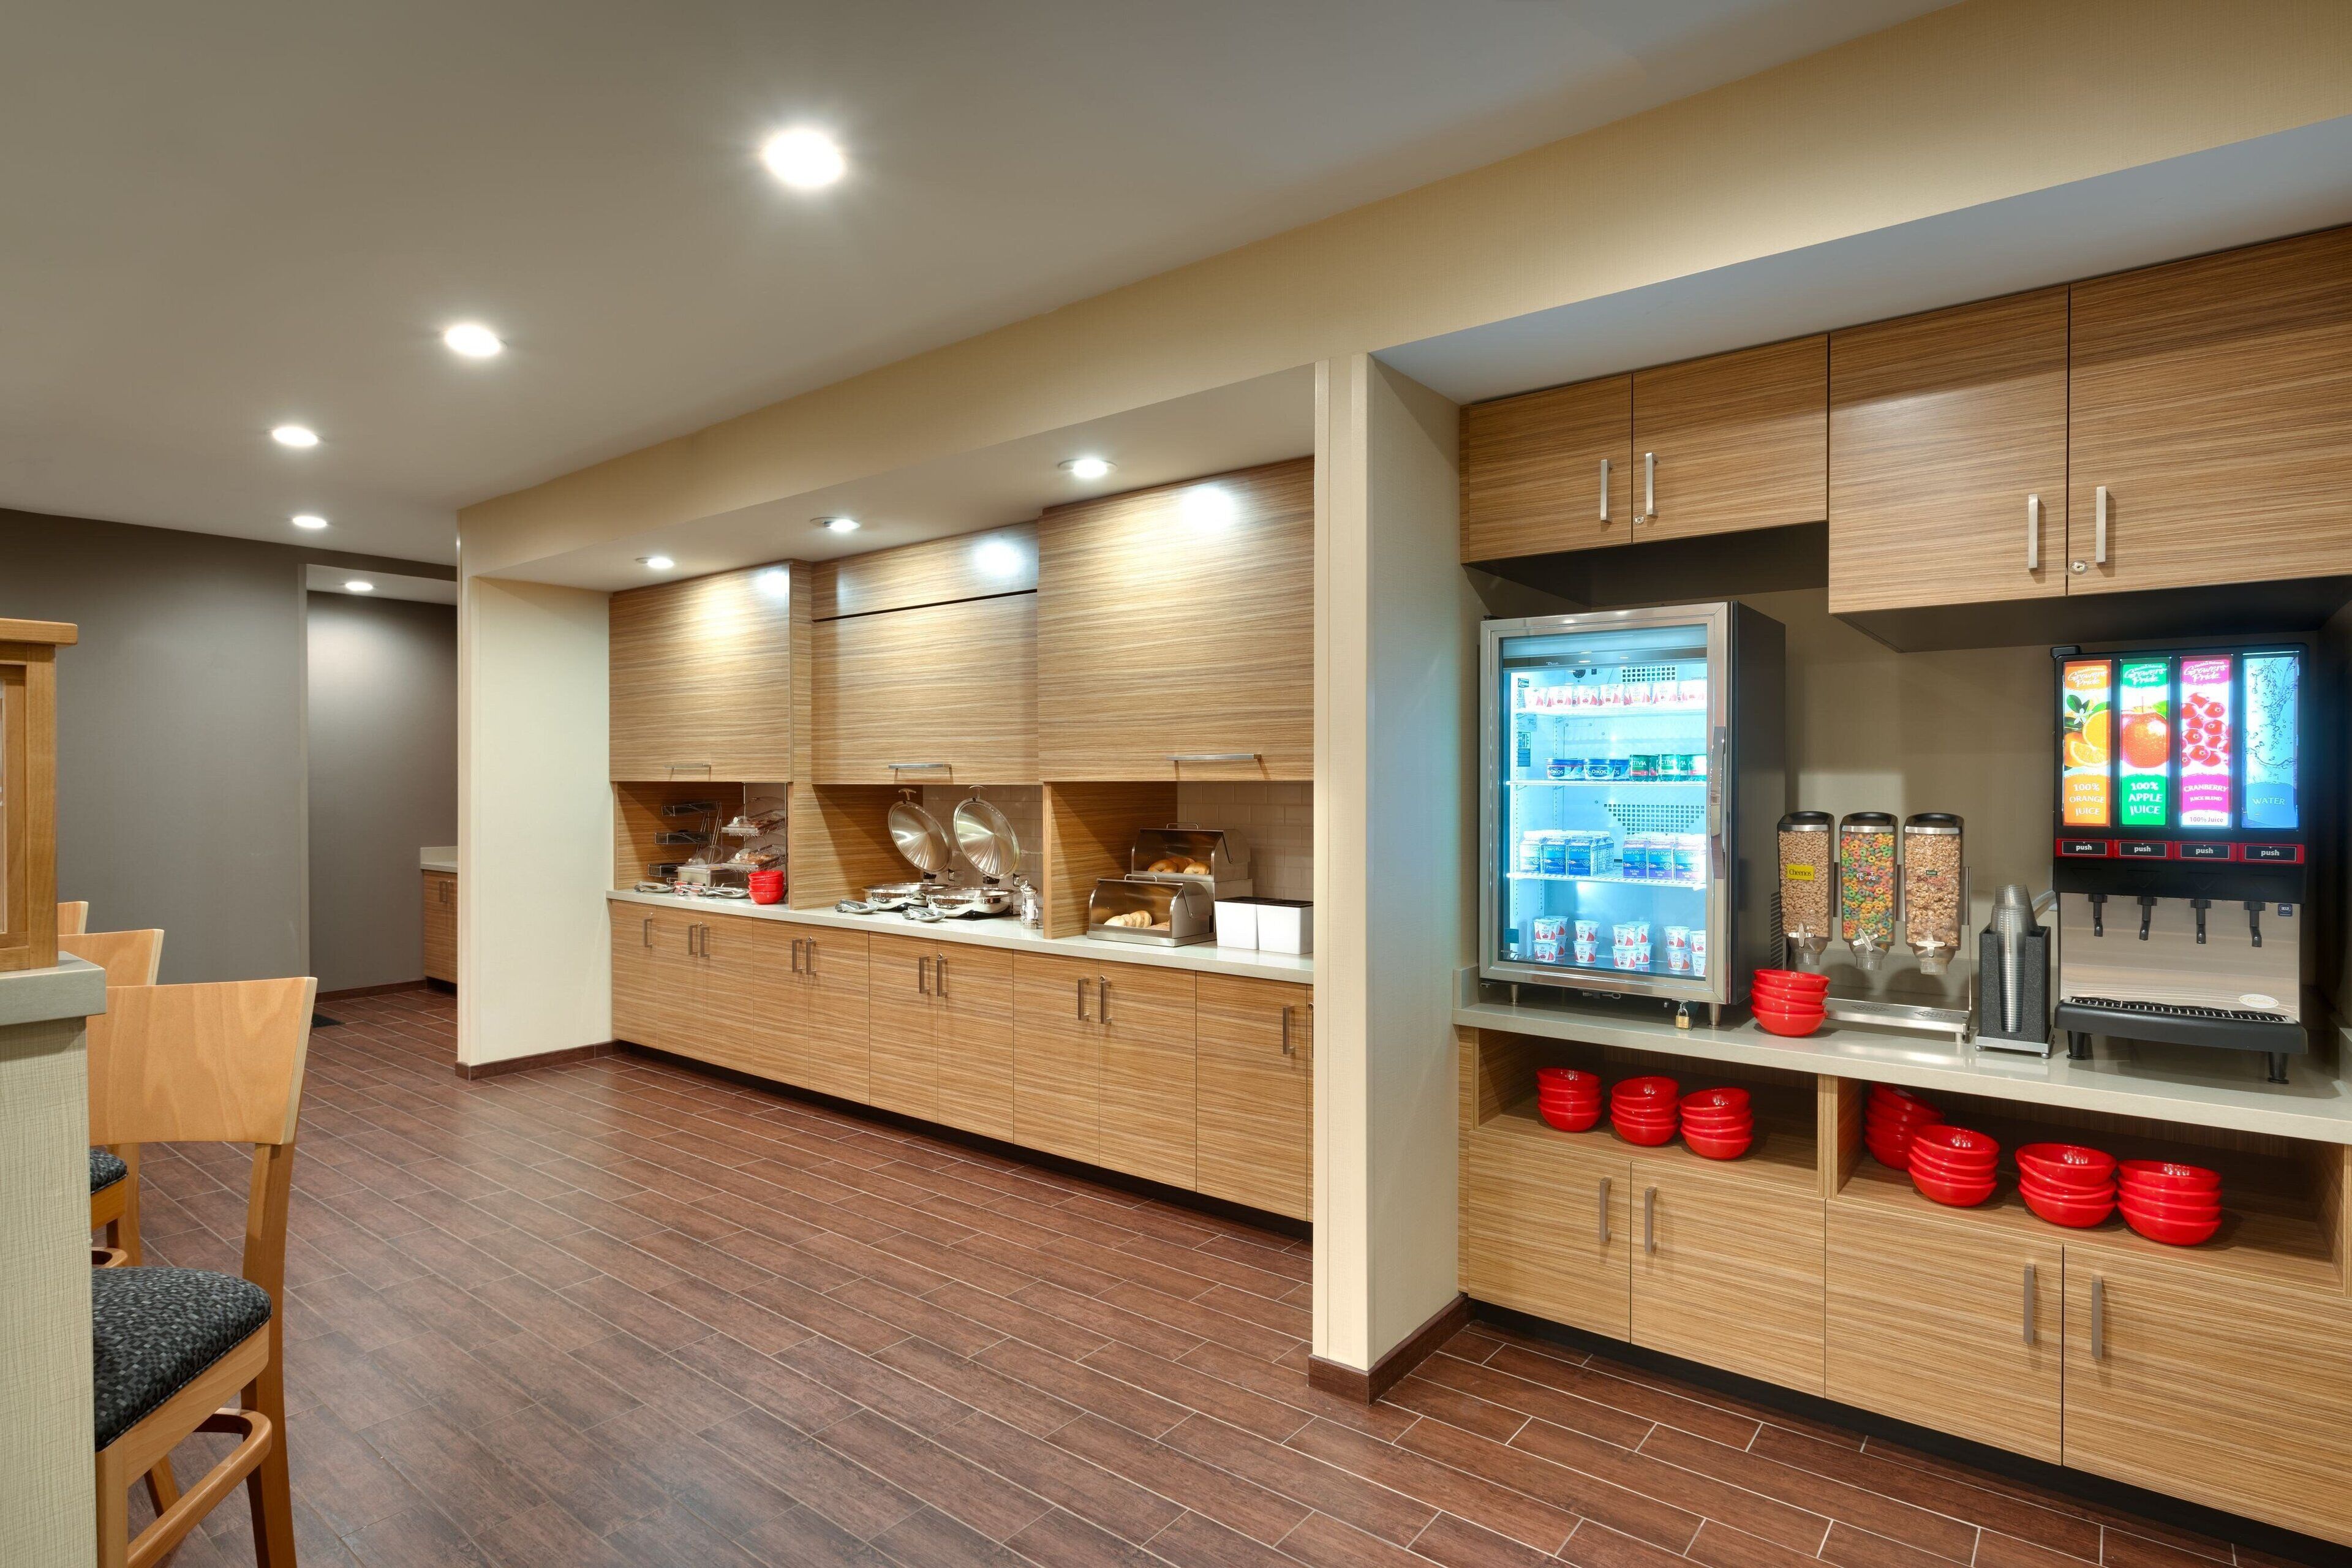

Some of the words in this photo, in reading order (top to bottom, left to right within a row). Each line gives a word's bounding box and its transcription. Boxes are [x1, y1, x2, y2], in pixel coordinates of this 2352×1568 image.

[2184, 665, 2229, 676] Growers
[2068, 671, 2108, 681] Growers
[2191, 671, 2222, 683] Pride
[2075, 677, 2101, 687] Pride
[2073, 783, 2100, 791] 100%
[2131, 782, 2159, 791] 100%
[2184, 784, 2229, 793] CRANBERRY
[2128, 793, 2163, 802] APPLE
[2252, 797, 2285, 805] WATER
[2075, 807, 2100, 816] JUICE
[2130, 805, 2160, 816] JUICE
